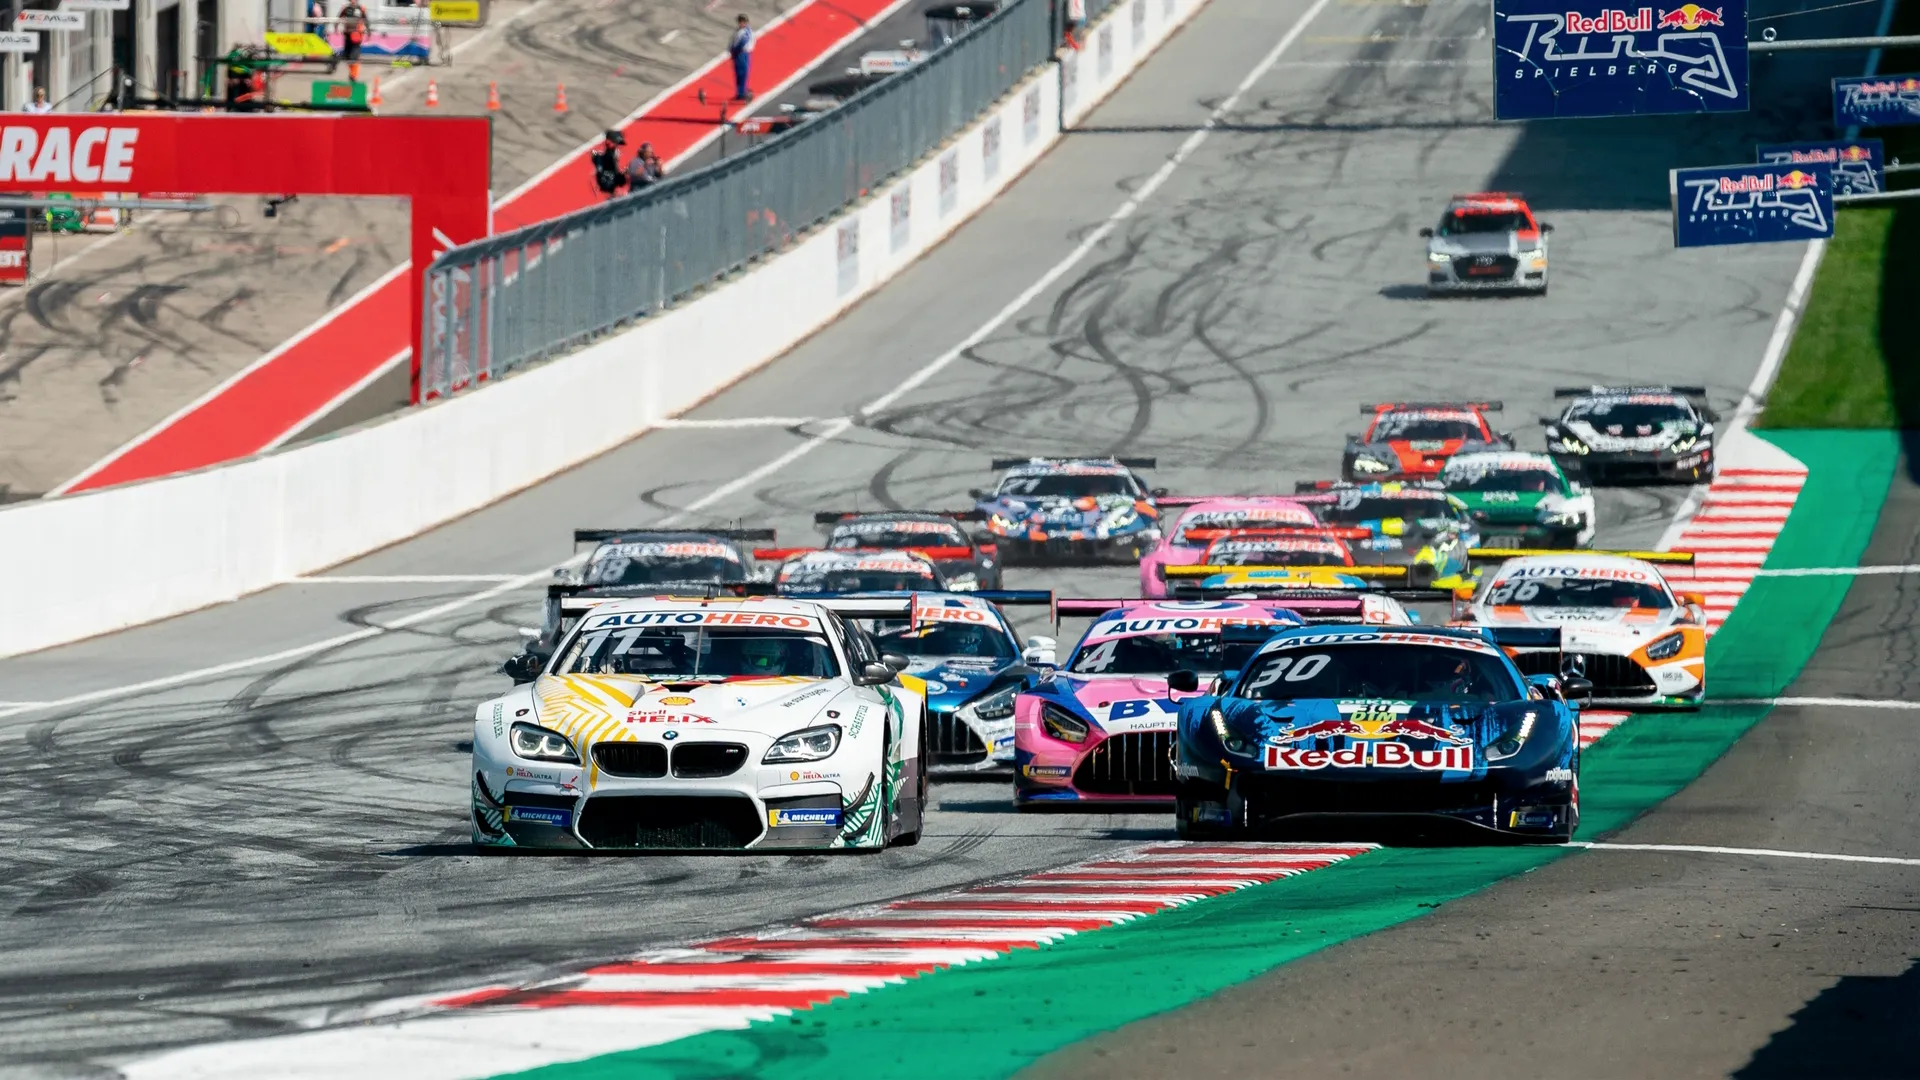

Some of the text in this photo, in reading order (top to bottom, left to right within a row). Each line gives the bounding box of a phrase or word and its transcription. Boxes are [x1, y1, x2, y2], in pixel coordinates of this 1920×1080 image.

[1567, 8, 1652, 33] Red Bull
[1515, 64, 1677, 79] SPIELBERG
[1720, 174, 1774, 194] Red Bull
[1510, 566, 1648, 581] AUTOHERO
[594, 612, 810, 628] AUTOHERO
[580, 627, 646, 658] 11
[1276, 634, 1485, 650] AUTOHERO
[1074, 639, 1120, 673] 4
[1250, 654, 1332, 689] 30
[626, 712, 718, 724] HELIX
[629, 709, 666, 717] Shell
[1350, 711, 1397, 721] DTM
[1267, 742, 1471, 769] Red Bull
[803, 772, 822, 780] HELIX
[1036, 766, 1067, 776] MICHELIN
[521, 811, 563, 821] MICHELIN
[791, 813, 835, 822] MICHELIN
